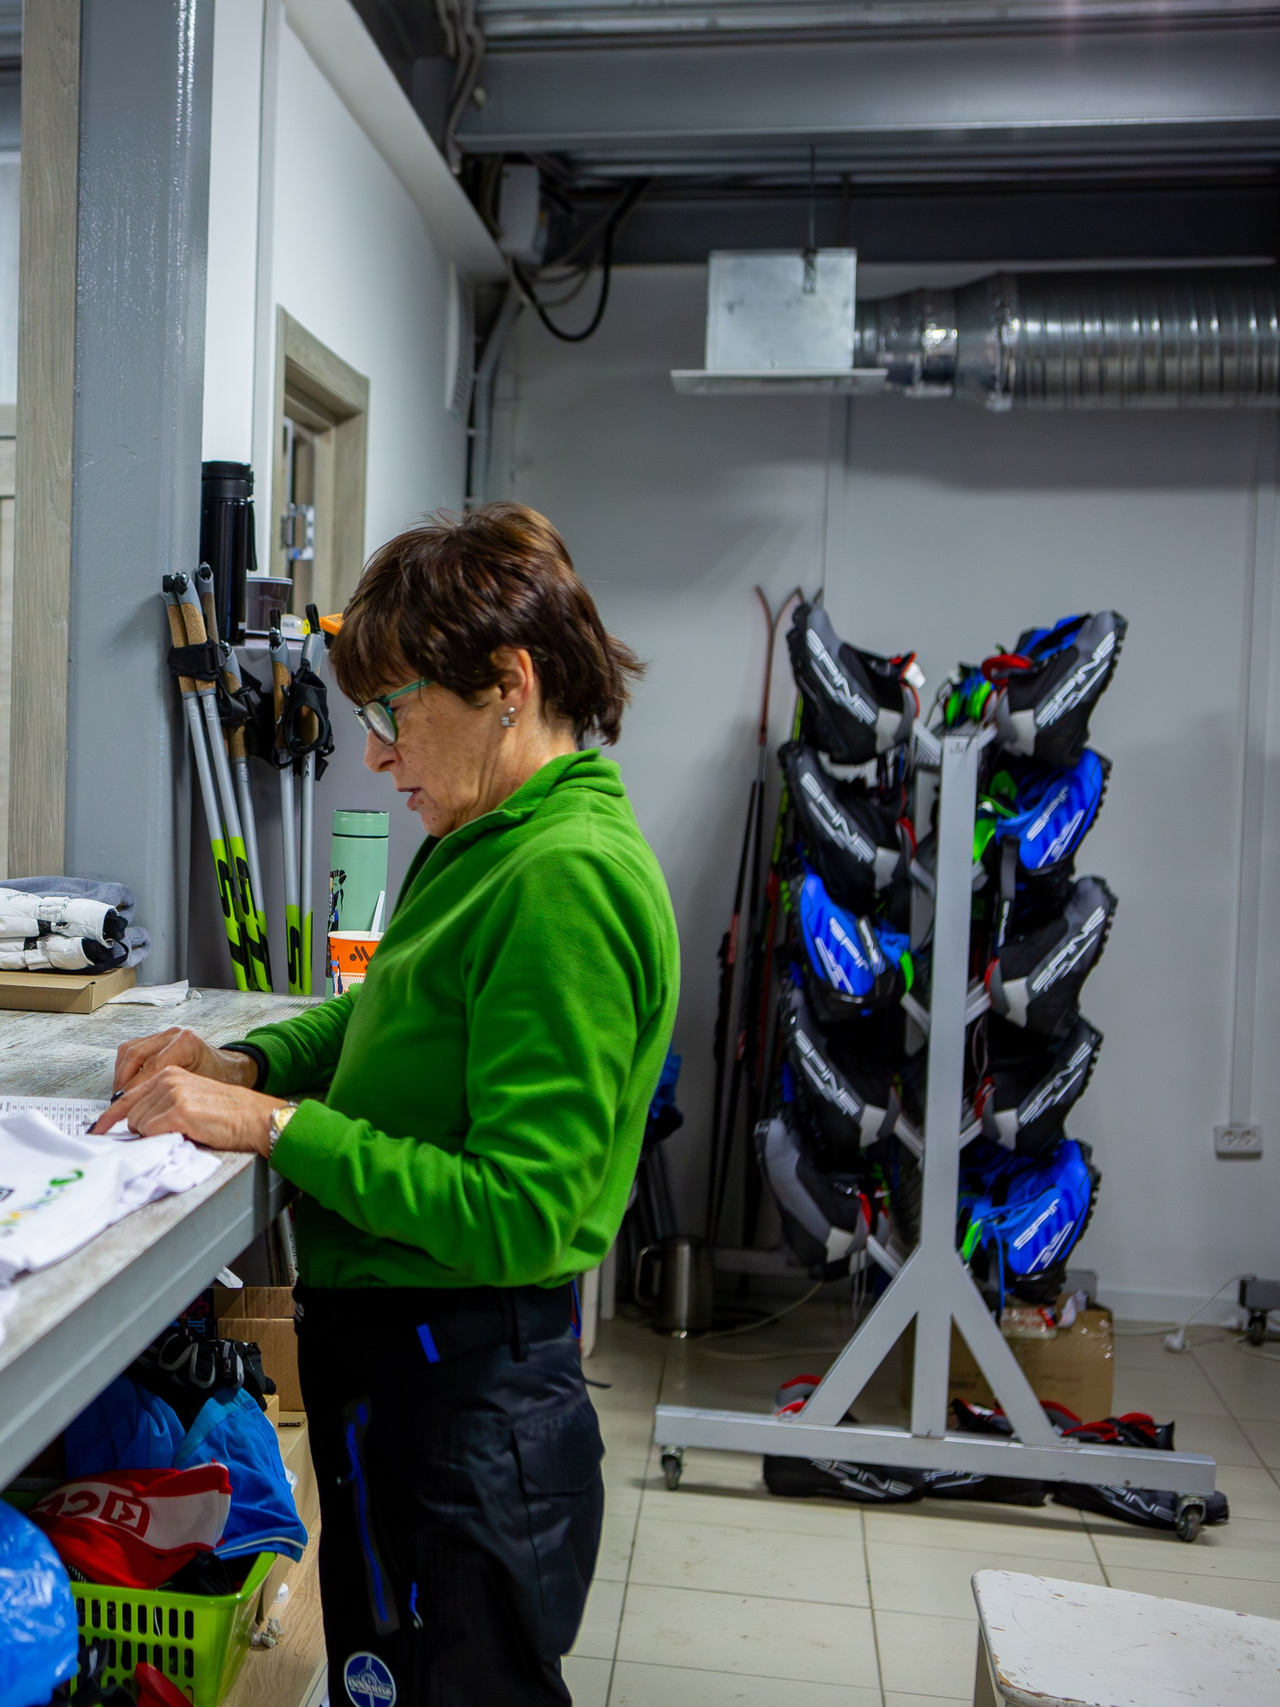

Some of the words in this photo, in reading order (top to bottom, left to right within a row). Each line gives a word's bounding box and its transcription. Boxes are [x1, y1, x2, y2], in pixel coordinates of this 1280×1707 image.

[806, 628, 878, 725] SPINE
[1035, 631, 1116, 728] SPINE
[800, 771, 876, 864] SPINE
[1031, 906, 1106, 994] SPINE
[795, 1029, 861, 1117] SPINE
[1100, 1484, 1177, 1521] PINE
